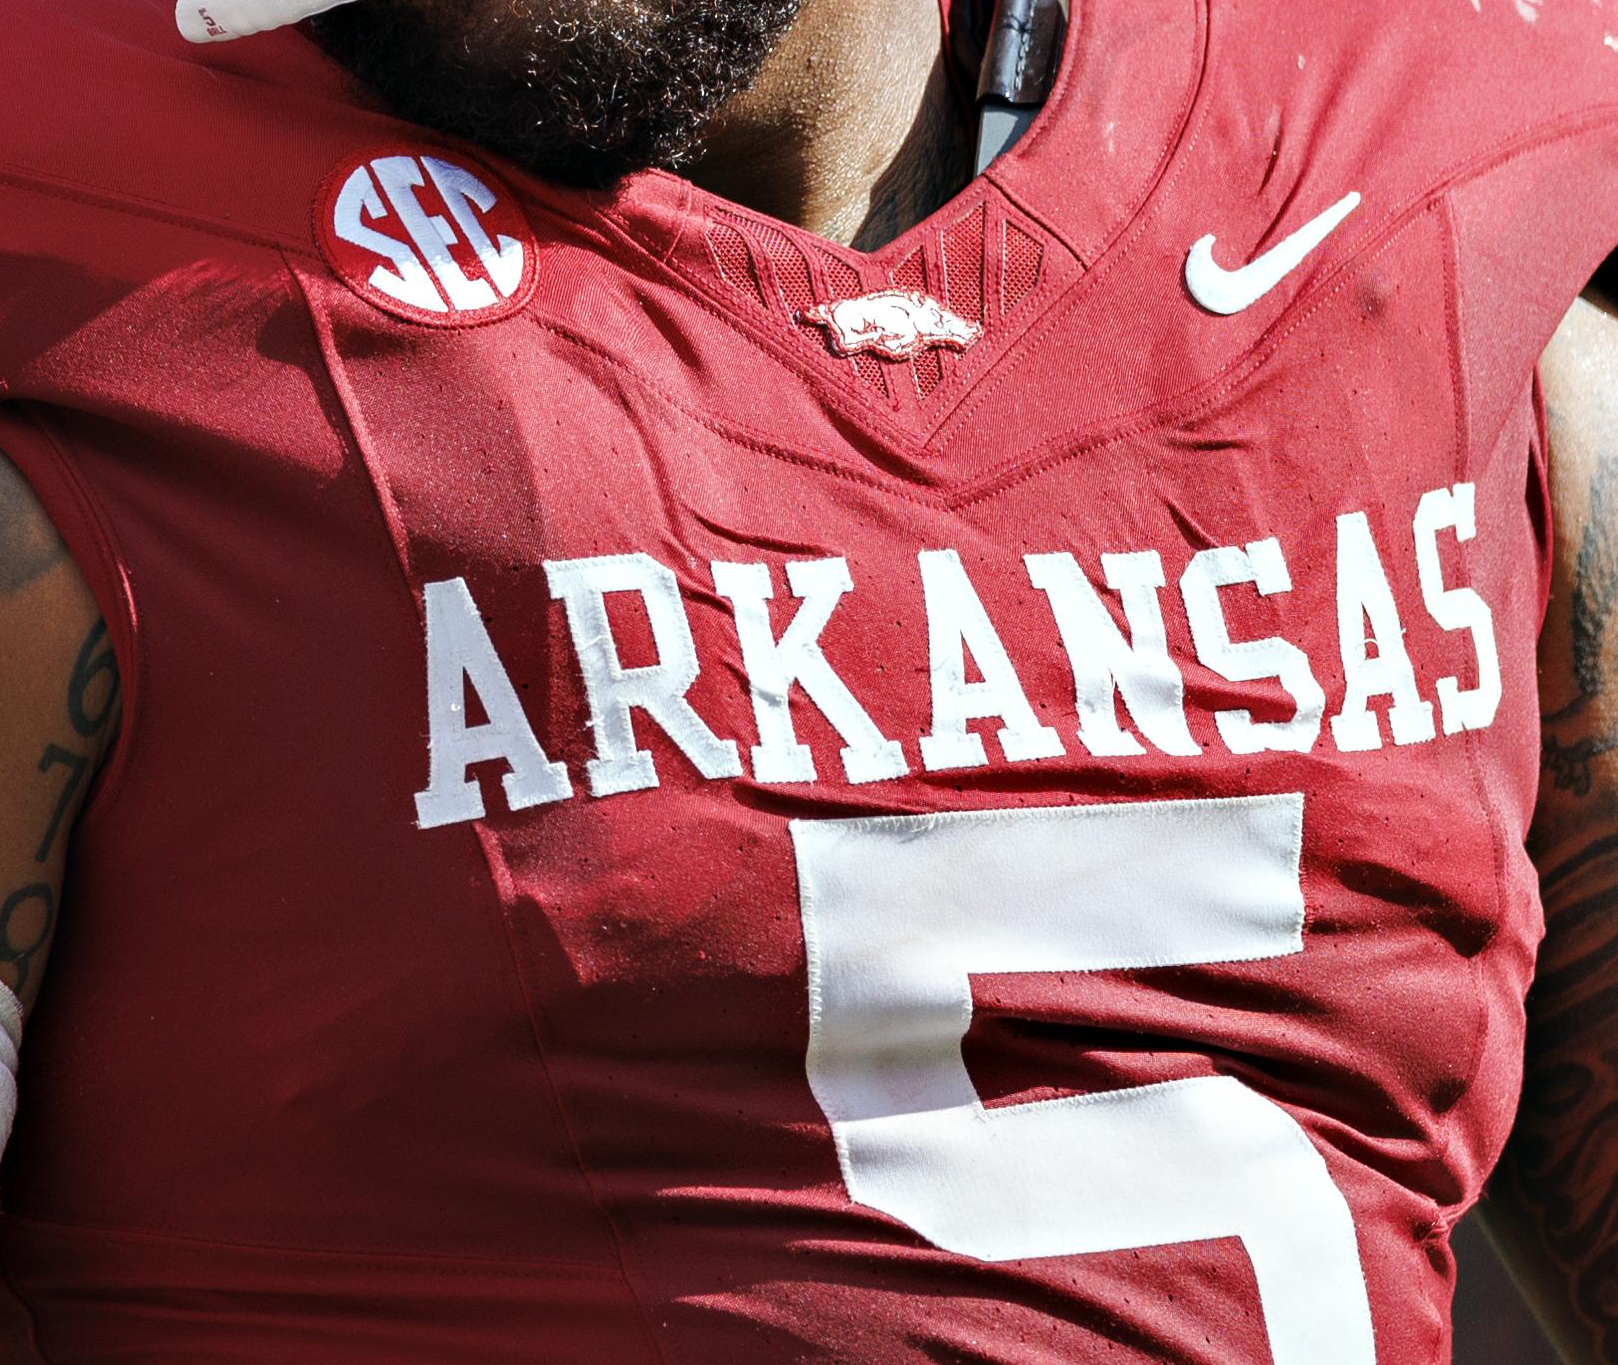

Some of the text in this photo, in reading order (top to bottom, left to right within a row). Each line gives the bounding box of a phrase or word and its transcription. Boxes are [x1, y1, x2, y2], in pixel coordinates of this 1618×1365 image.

[333, 155, 524, 313] SEC
[414, 482, 1502, 829] ARKANSAS
[788, 792, 1378, 1365] 5
